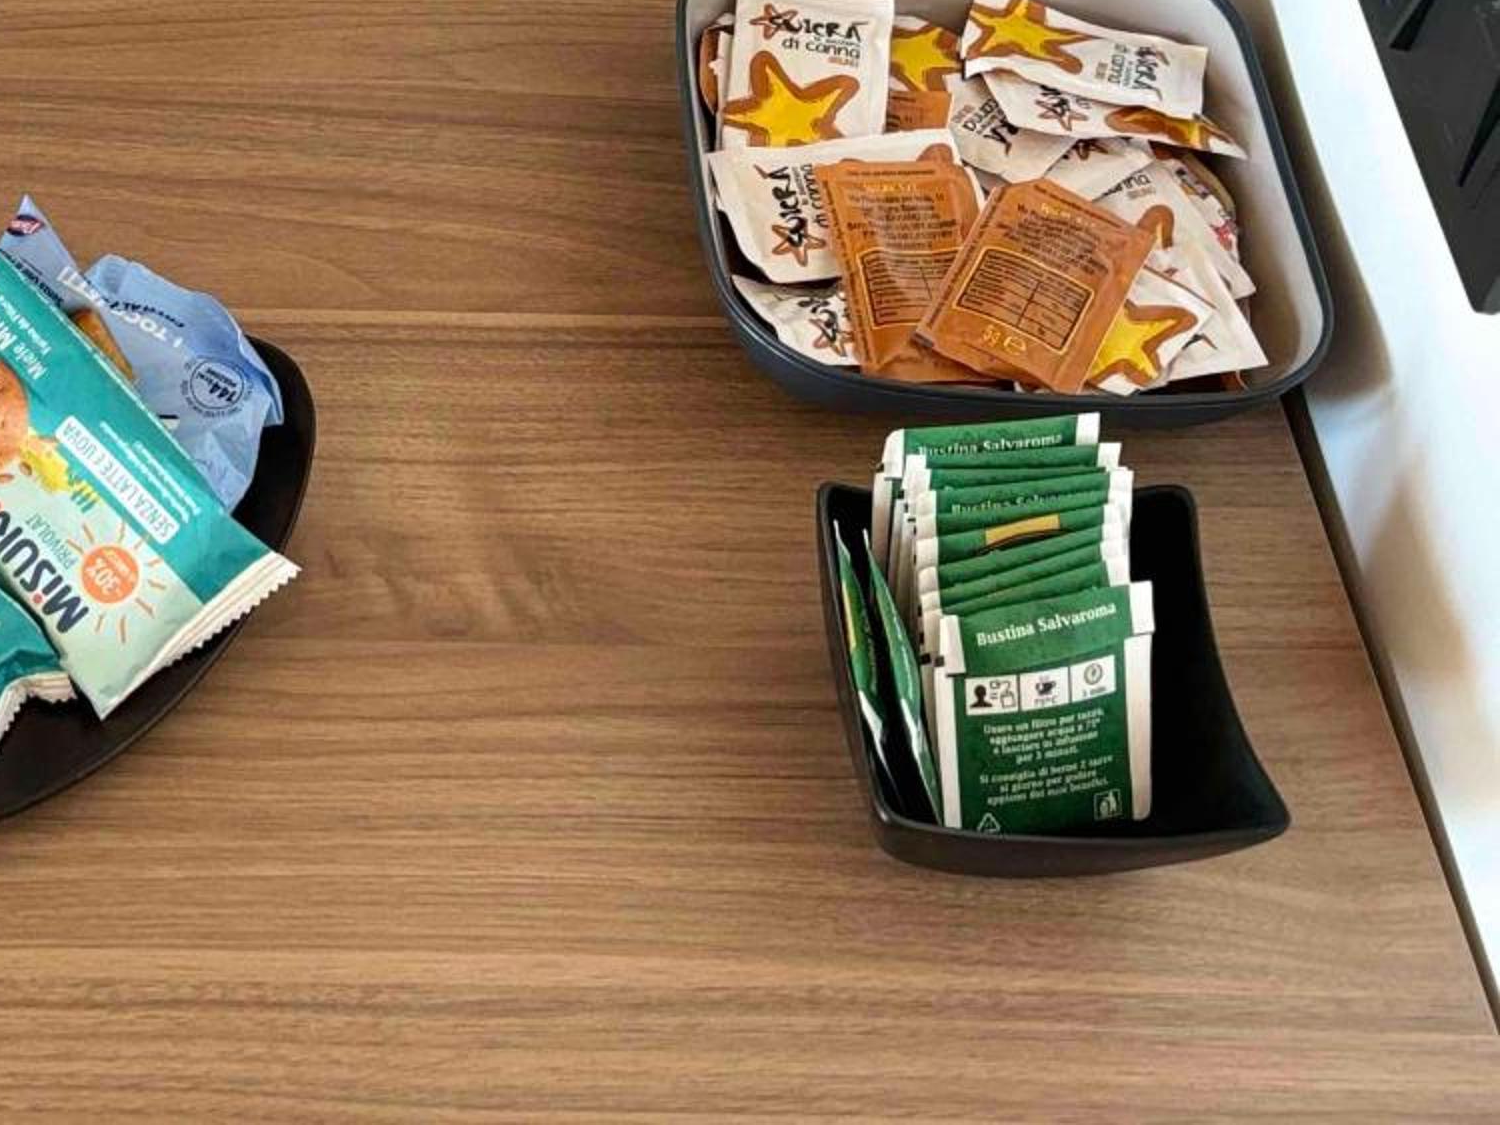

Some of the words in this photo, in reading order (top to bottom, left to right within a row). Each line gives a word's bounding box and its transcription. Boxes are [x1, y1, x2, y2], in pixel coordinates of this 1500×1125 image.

[782, 37, 799, 50] di
[805, 41, 860, 59] canna
[8, 340, 49, 381] Miele
[59, 420, 100, 461] UOVA
[918, 443, 978, 456] Bustina
[983, 433, 1063, 451] Salvaroma
[96, 459, 141, 503] LATTE
[130, 494, 175, 539] SENZA
[26, 513, 78, 571] PRIVOLAT
[976, 623, 1035, 646] Bustina
[1037, 603, 1116, 632] Salvaroma
